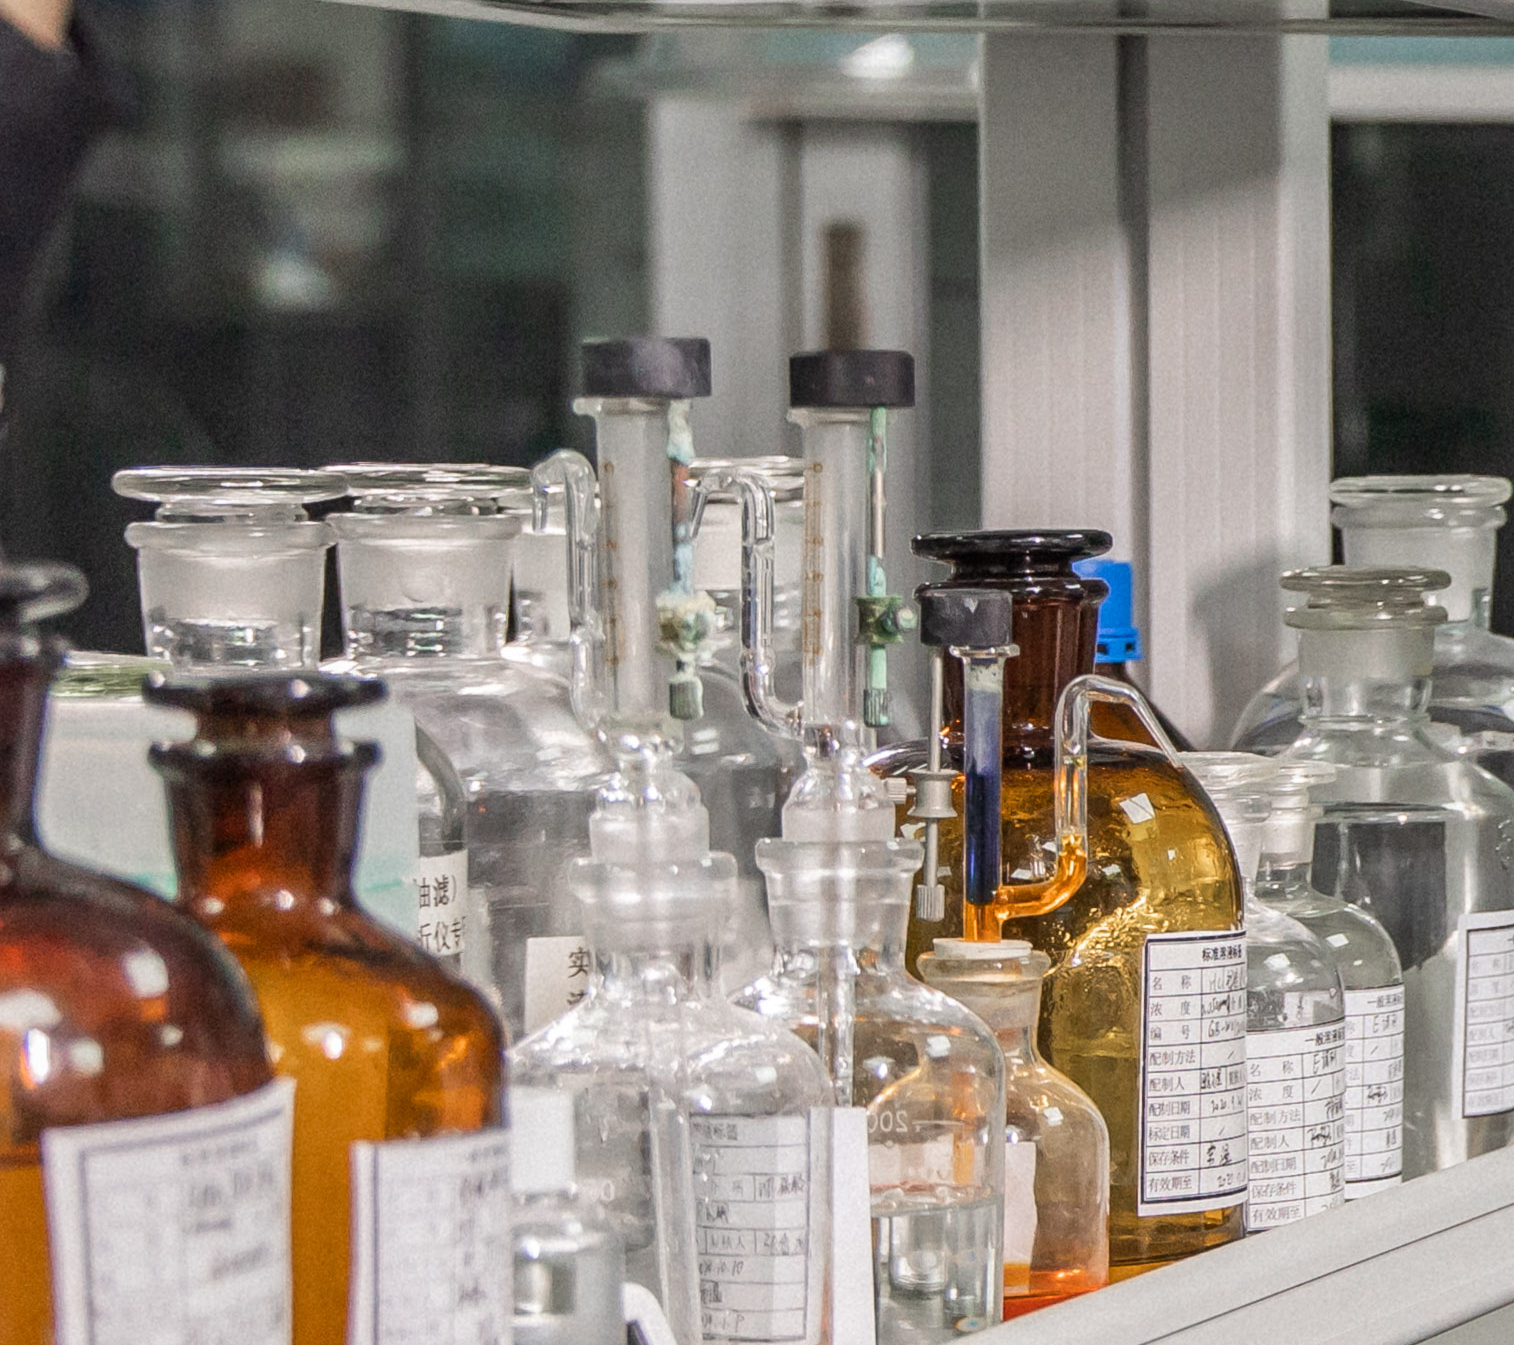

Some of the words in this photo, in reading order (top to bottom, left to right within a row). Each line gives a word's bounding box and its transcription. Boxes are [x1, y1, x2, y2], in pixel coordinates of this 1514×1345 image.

[1152, 974, 1192, 991] 名称
[1150, 1000, 1191, 1017] 浓度
[1149, 1048, 1196, 1067] 配制方法
[1249, 1059, 1295, 1078] 名称
[1149, 1075, 1185, 1093] 配制人
[1248, 1083, 1295, 1102] 浓度
[1149, 1100, 1192, 1117] 配制日期
[1249, 1107, 1301, 1127] 配制方法
[1148, 1124, 1191, 1141] 标定日期
[1250, 1133, 1290, 1150] 配制人
[1148, 1149, 1190, 1167] 保存条件
[1250, 1156, 1298, 1175] 配制日期
[1148, 1174, 1193, 1193] 有效期至
[1251, 1180, 1297, 1199] 保存条件
[1252, 1204, 1302, 1224] 有效期至
